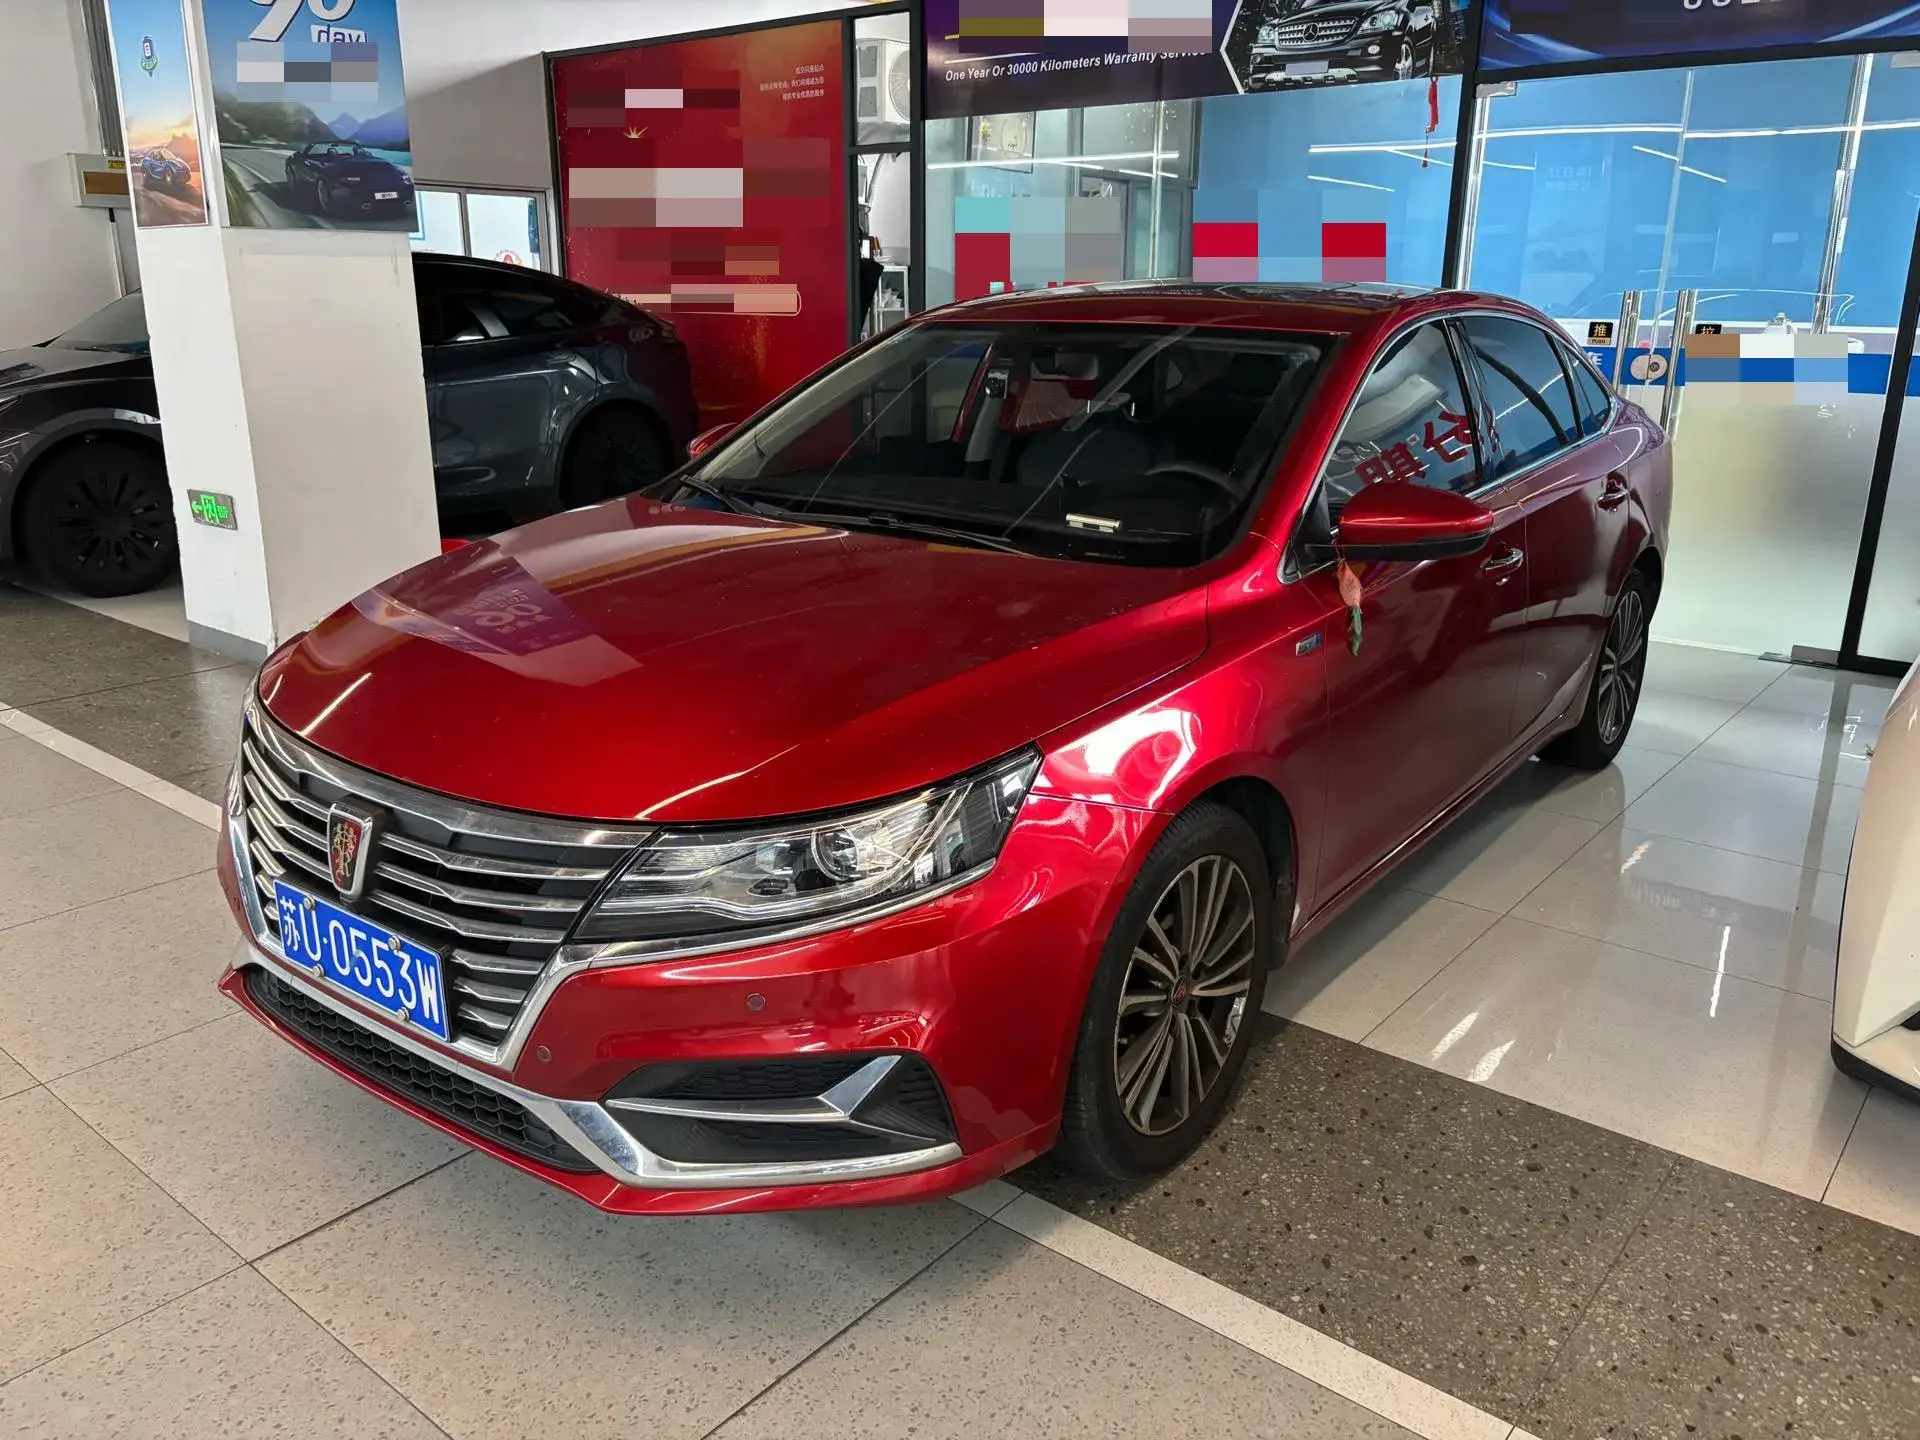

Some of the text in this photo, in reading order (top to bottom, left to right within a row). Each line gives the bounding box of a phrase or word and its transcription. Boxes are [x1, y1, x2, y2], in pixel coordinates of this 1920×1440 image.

[945, 70, 966, 81] One
[967, 67, 991, 79] Year
[992, 65, 1006, 76] Or
[1007, 61, 1038, 75] 30000
[1040, 56, 1101, 72] Kilometers
[1104, 52, 1157, 65] Warranty
[1593, 323, 1608, 337] 推
